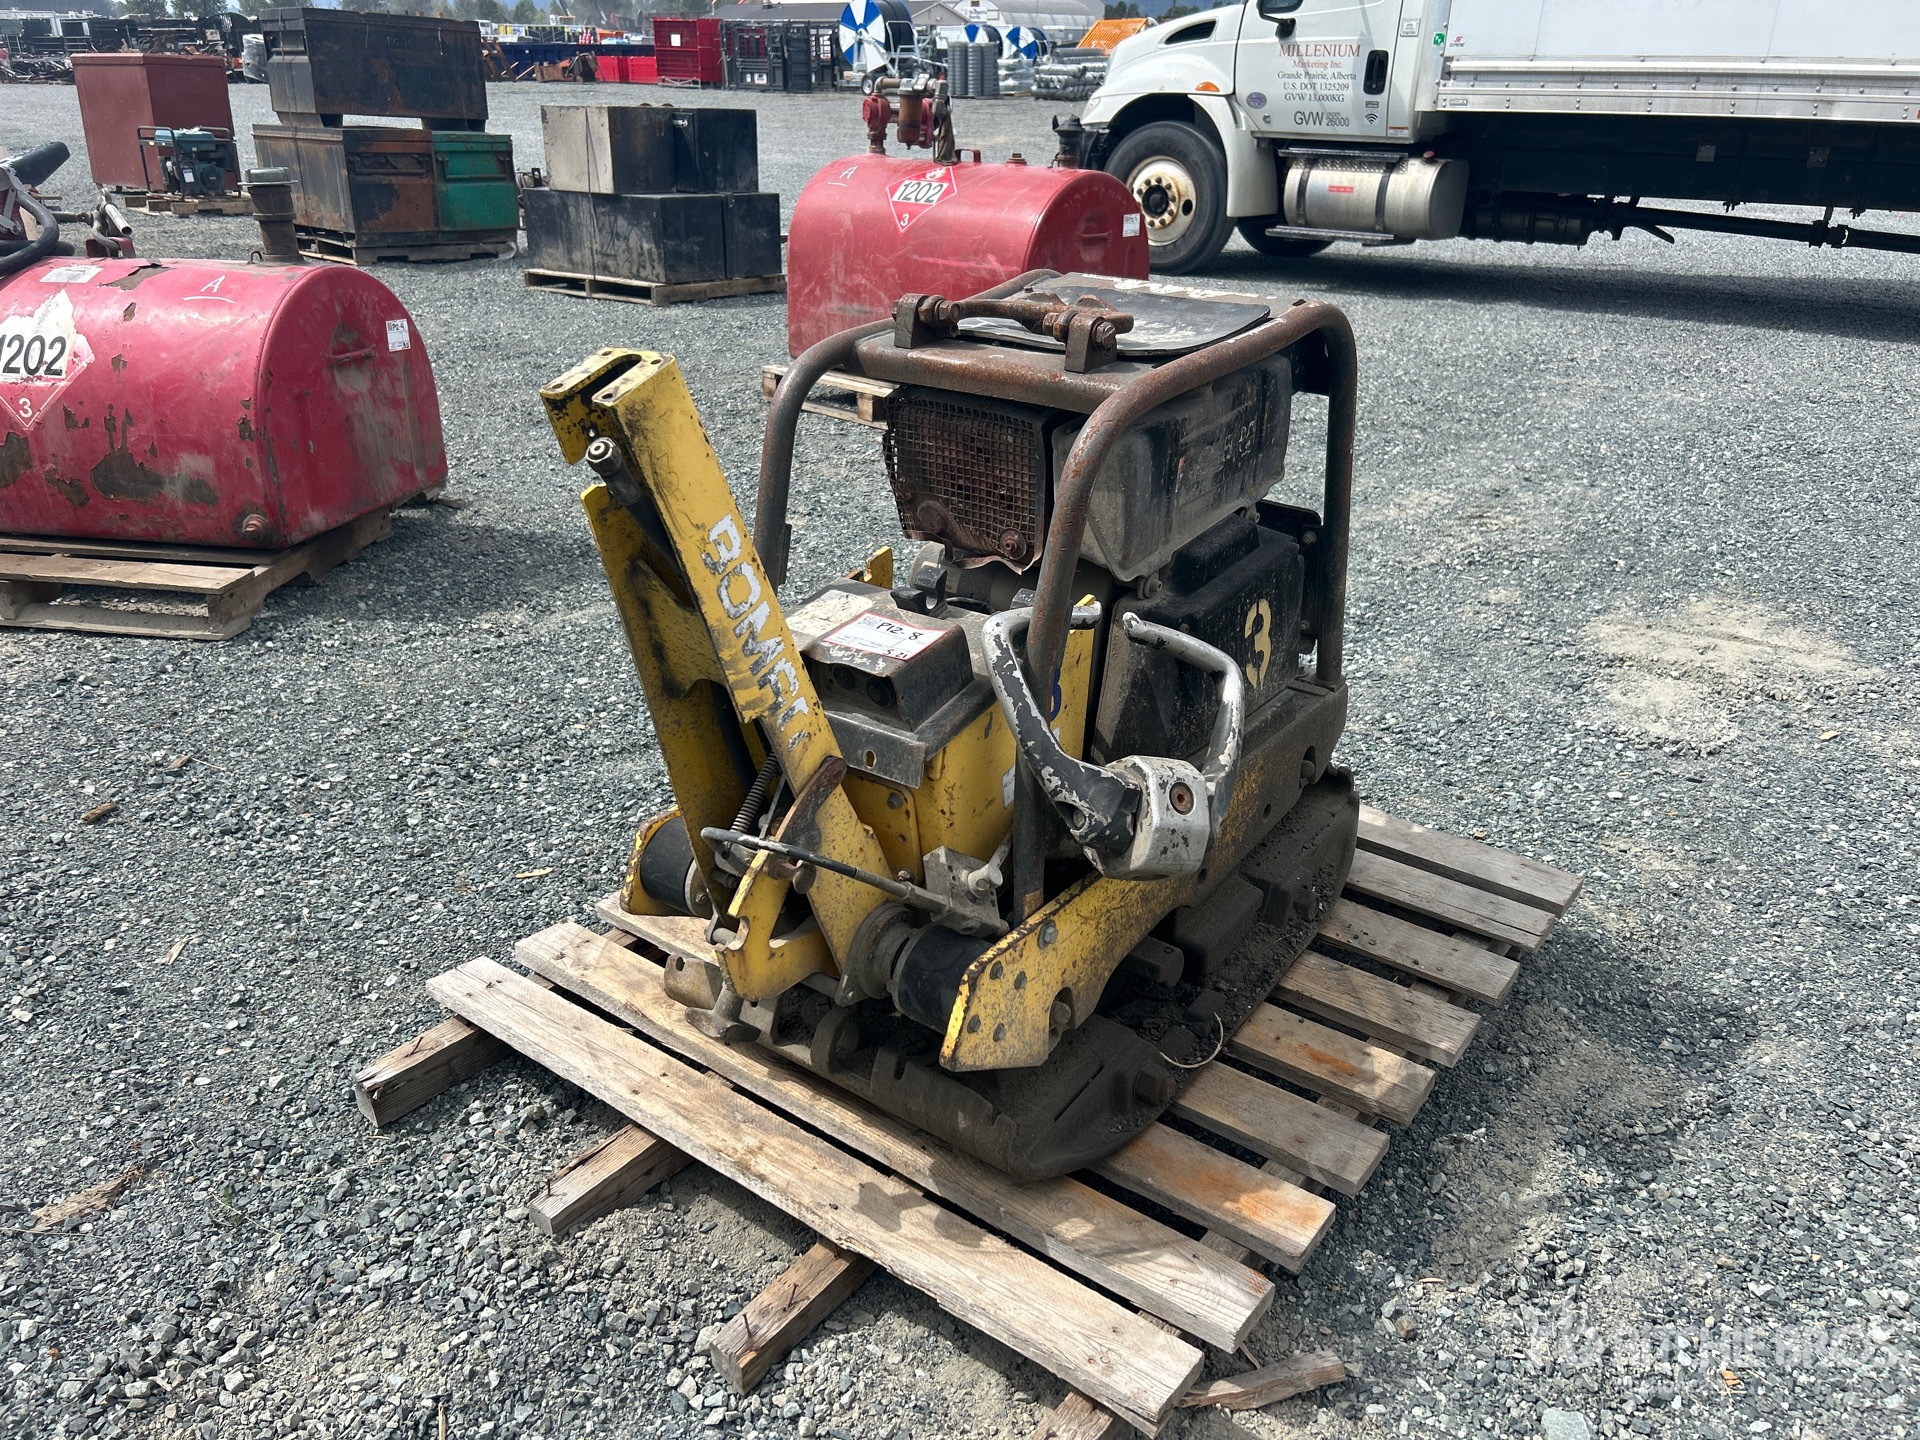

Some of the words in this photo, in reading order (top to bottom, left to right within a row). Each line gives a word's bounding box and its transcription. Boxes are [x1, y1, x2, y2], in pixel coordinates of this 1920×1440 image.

[1279, 44, 1361, 58] MILLENIUM
[1293, 60, 1328, 70] Marketing
[1330, 60, 1343, 69] Inc.
[1278, 71, 1302, 80] Grande
[1304, 71, 1329, 81] Prairie,
[1330, 71, 1357, 80] Alberta
[1283, 82, 1298, 91] U.S.
[1300, 82, 1317, 91] DOT
[1319, 82, 1350, 92] 1325209
[1284, 93, 1307, 101] GVW
[1293, 110, 1324, 126] GVW
[1325, 117, 1350, 127] 26000
[897, 181, 944, 203] 1202
[900, 213, 910, 226] 3
[200, 275, 226, 293] A
[19, 397, 32, 418] 3
[1244, 598, 1272, 690] 3
